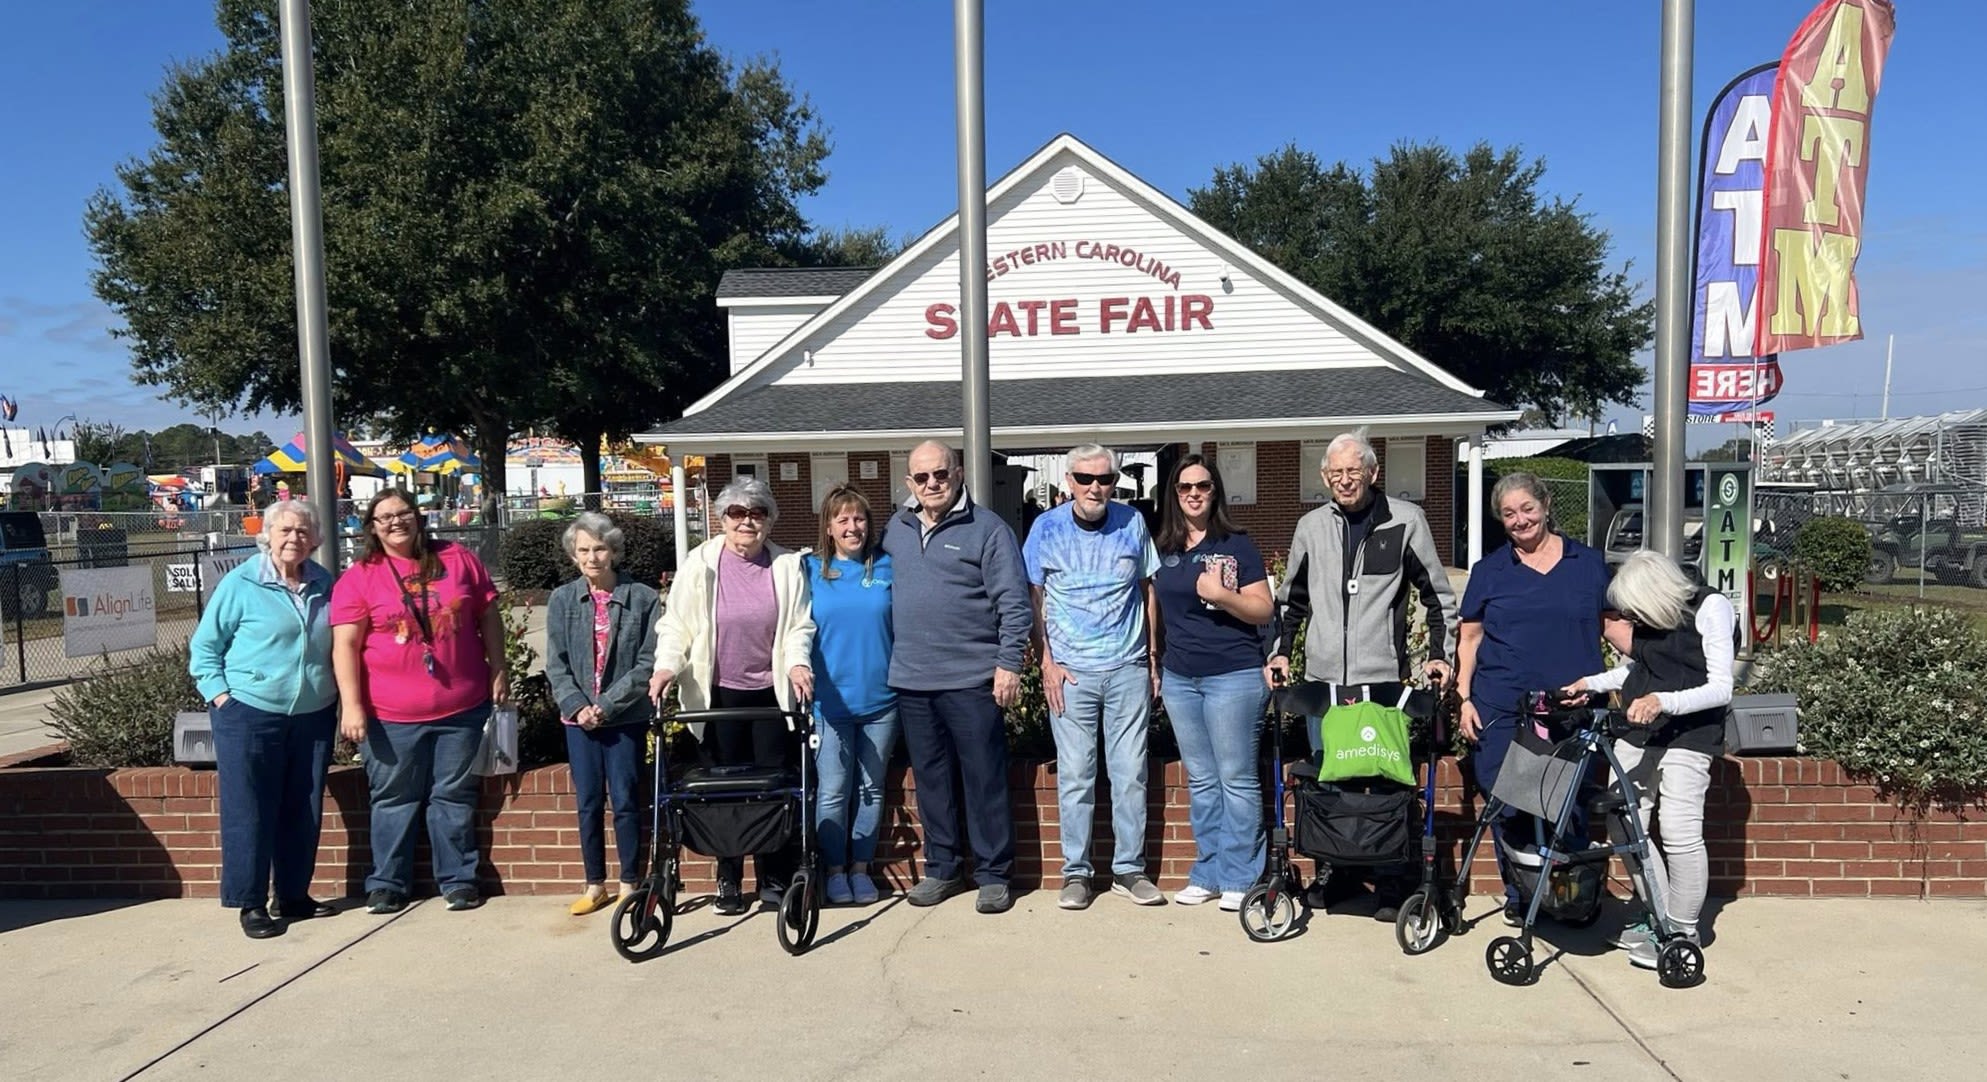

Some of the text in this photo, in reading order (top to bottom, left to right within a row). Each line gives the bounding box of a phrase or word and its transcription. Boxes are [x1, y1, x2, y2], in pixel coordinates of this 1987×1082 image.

[1769, 2, 1870, 338] ATM
[1703, 94, 1773, 358] ATM
[985, 240, 1182, 290] ESTERN CAROLINA
[924, 294, 1215, 340] SATE FAIR
[1718, 510, 1736, 591] ATM
[93, 589, 154, 621] AlignLife
[1336, 743, 1401, 761] amedisys
